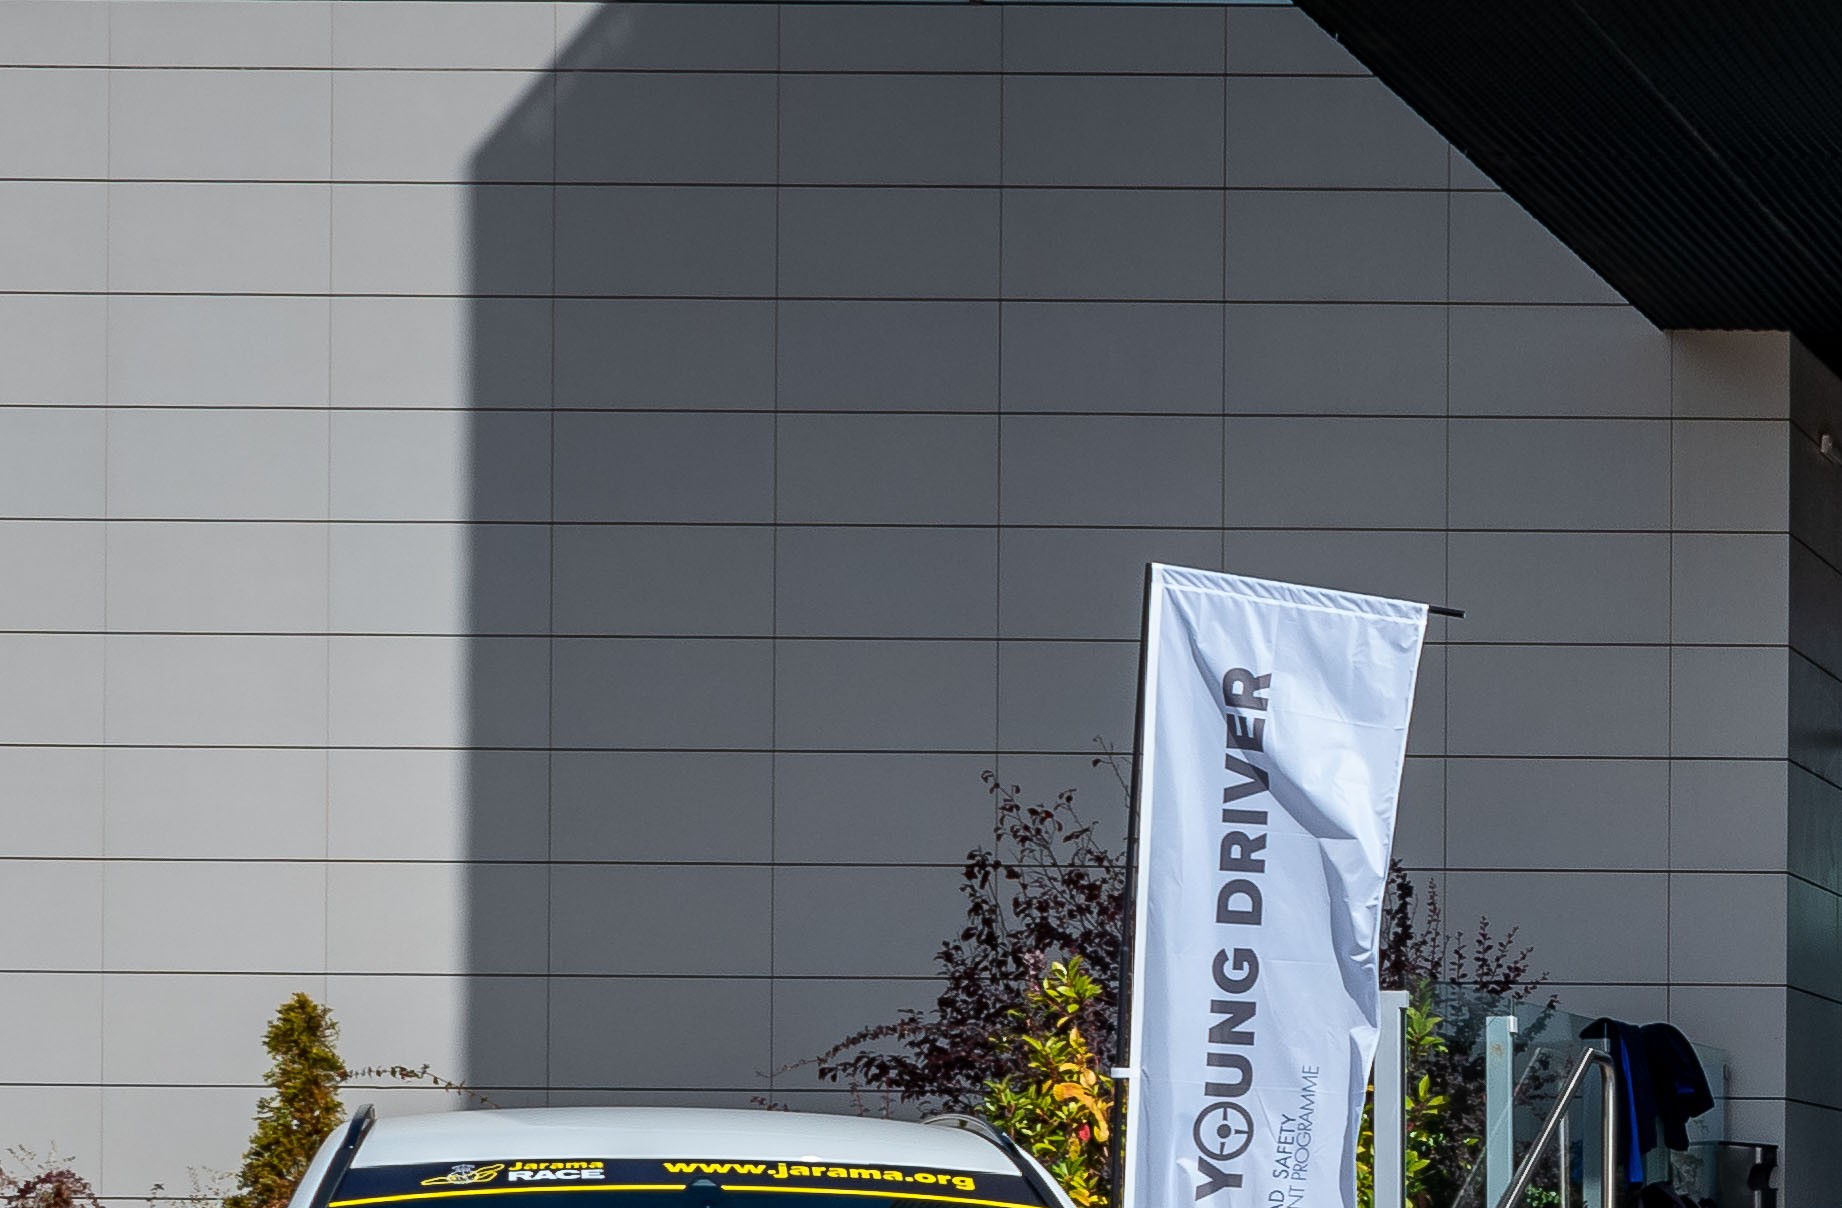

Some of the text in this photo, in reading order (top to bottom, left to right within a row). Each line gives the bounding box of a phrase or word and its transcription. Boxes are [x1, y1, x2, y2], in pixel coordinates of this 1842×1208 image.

[1216, 664, 1273, 928] DRIVER
[1194, 947, 1260, 1202] YOUNG
[1272, 1113, 1297, 1180] SAFETY
[1291, 1064, 1320, 1181] PROGRAMME
[506, 1159, 604, 1171] Jarama
[506, 1167, 606, 1182] RACE
[662, 1160, 977, 1191] www.jarama.org
